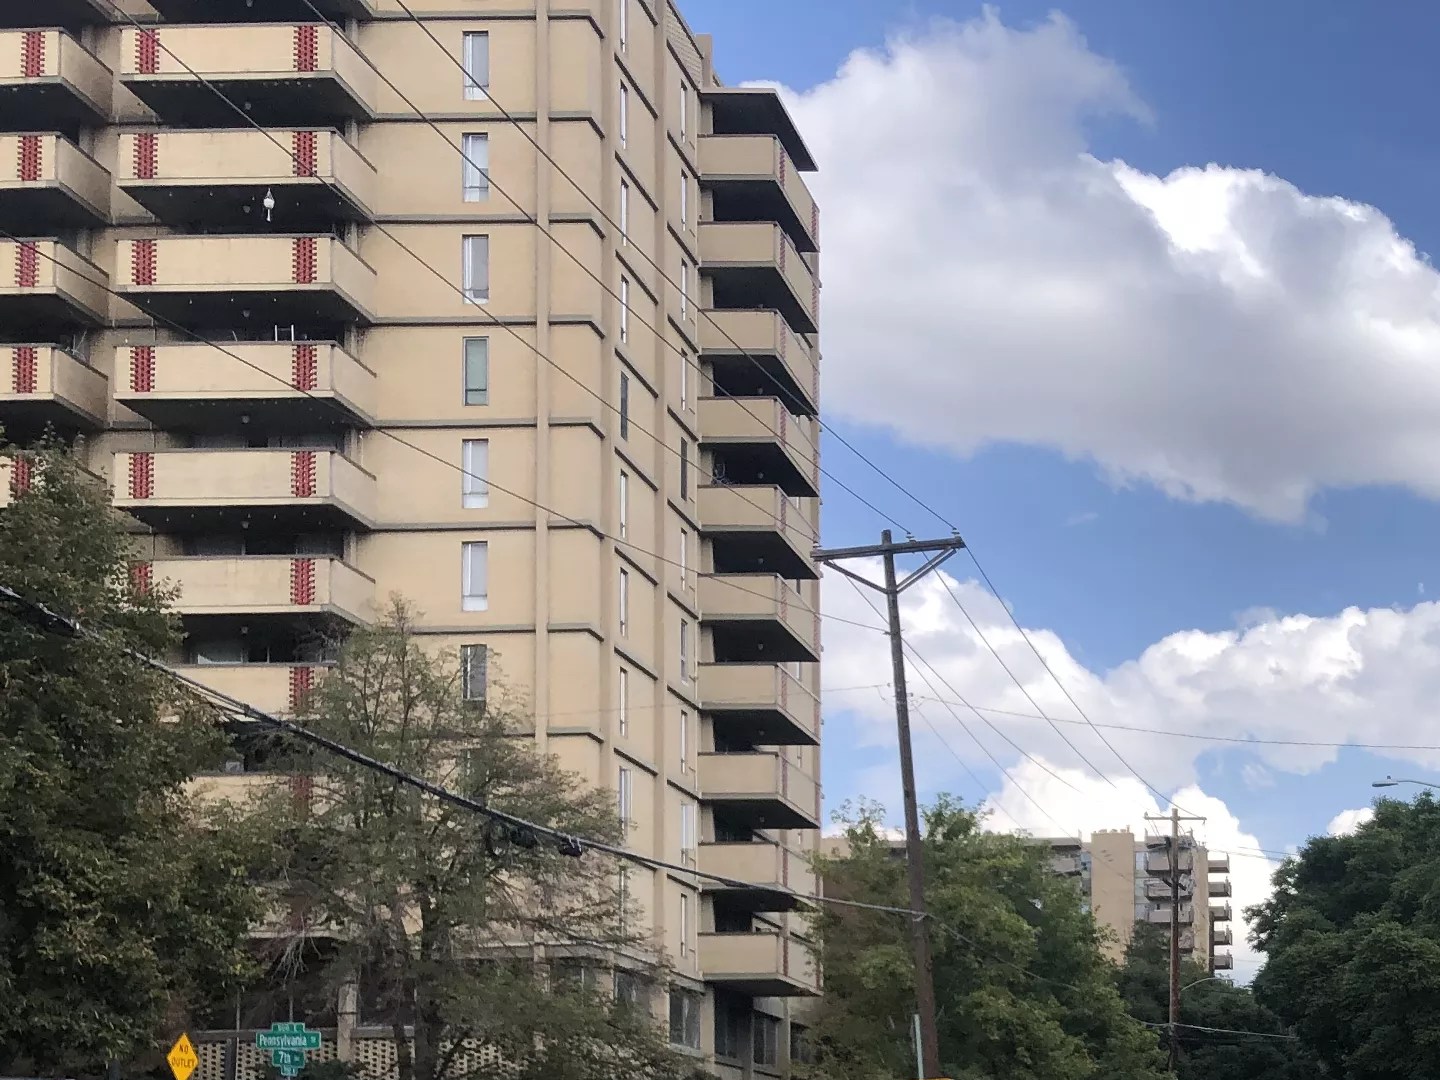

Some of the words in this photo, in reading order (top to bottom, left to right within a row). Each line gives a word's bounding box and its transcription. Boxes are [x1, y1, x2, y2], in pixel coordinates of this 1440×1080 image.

[259, 1034, 307, 1049] Pennsylvania
[179, 1044, 189, 1054] NO
[171, 1057, 195, 1068] OUTLET
[278, 1051, 291, 1064] 7th
